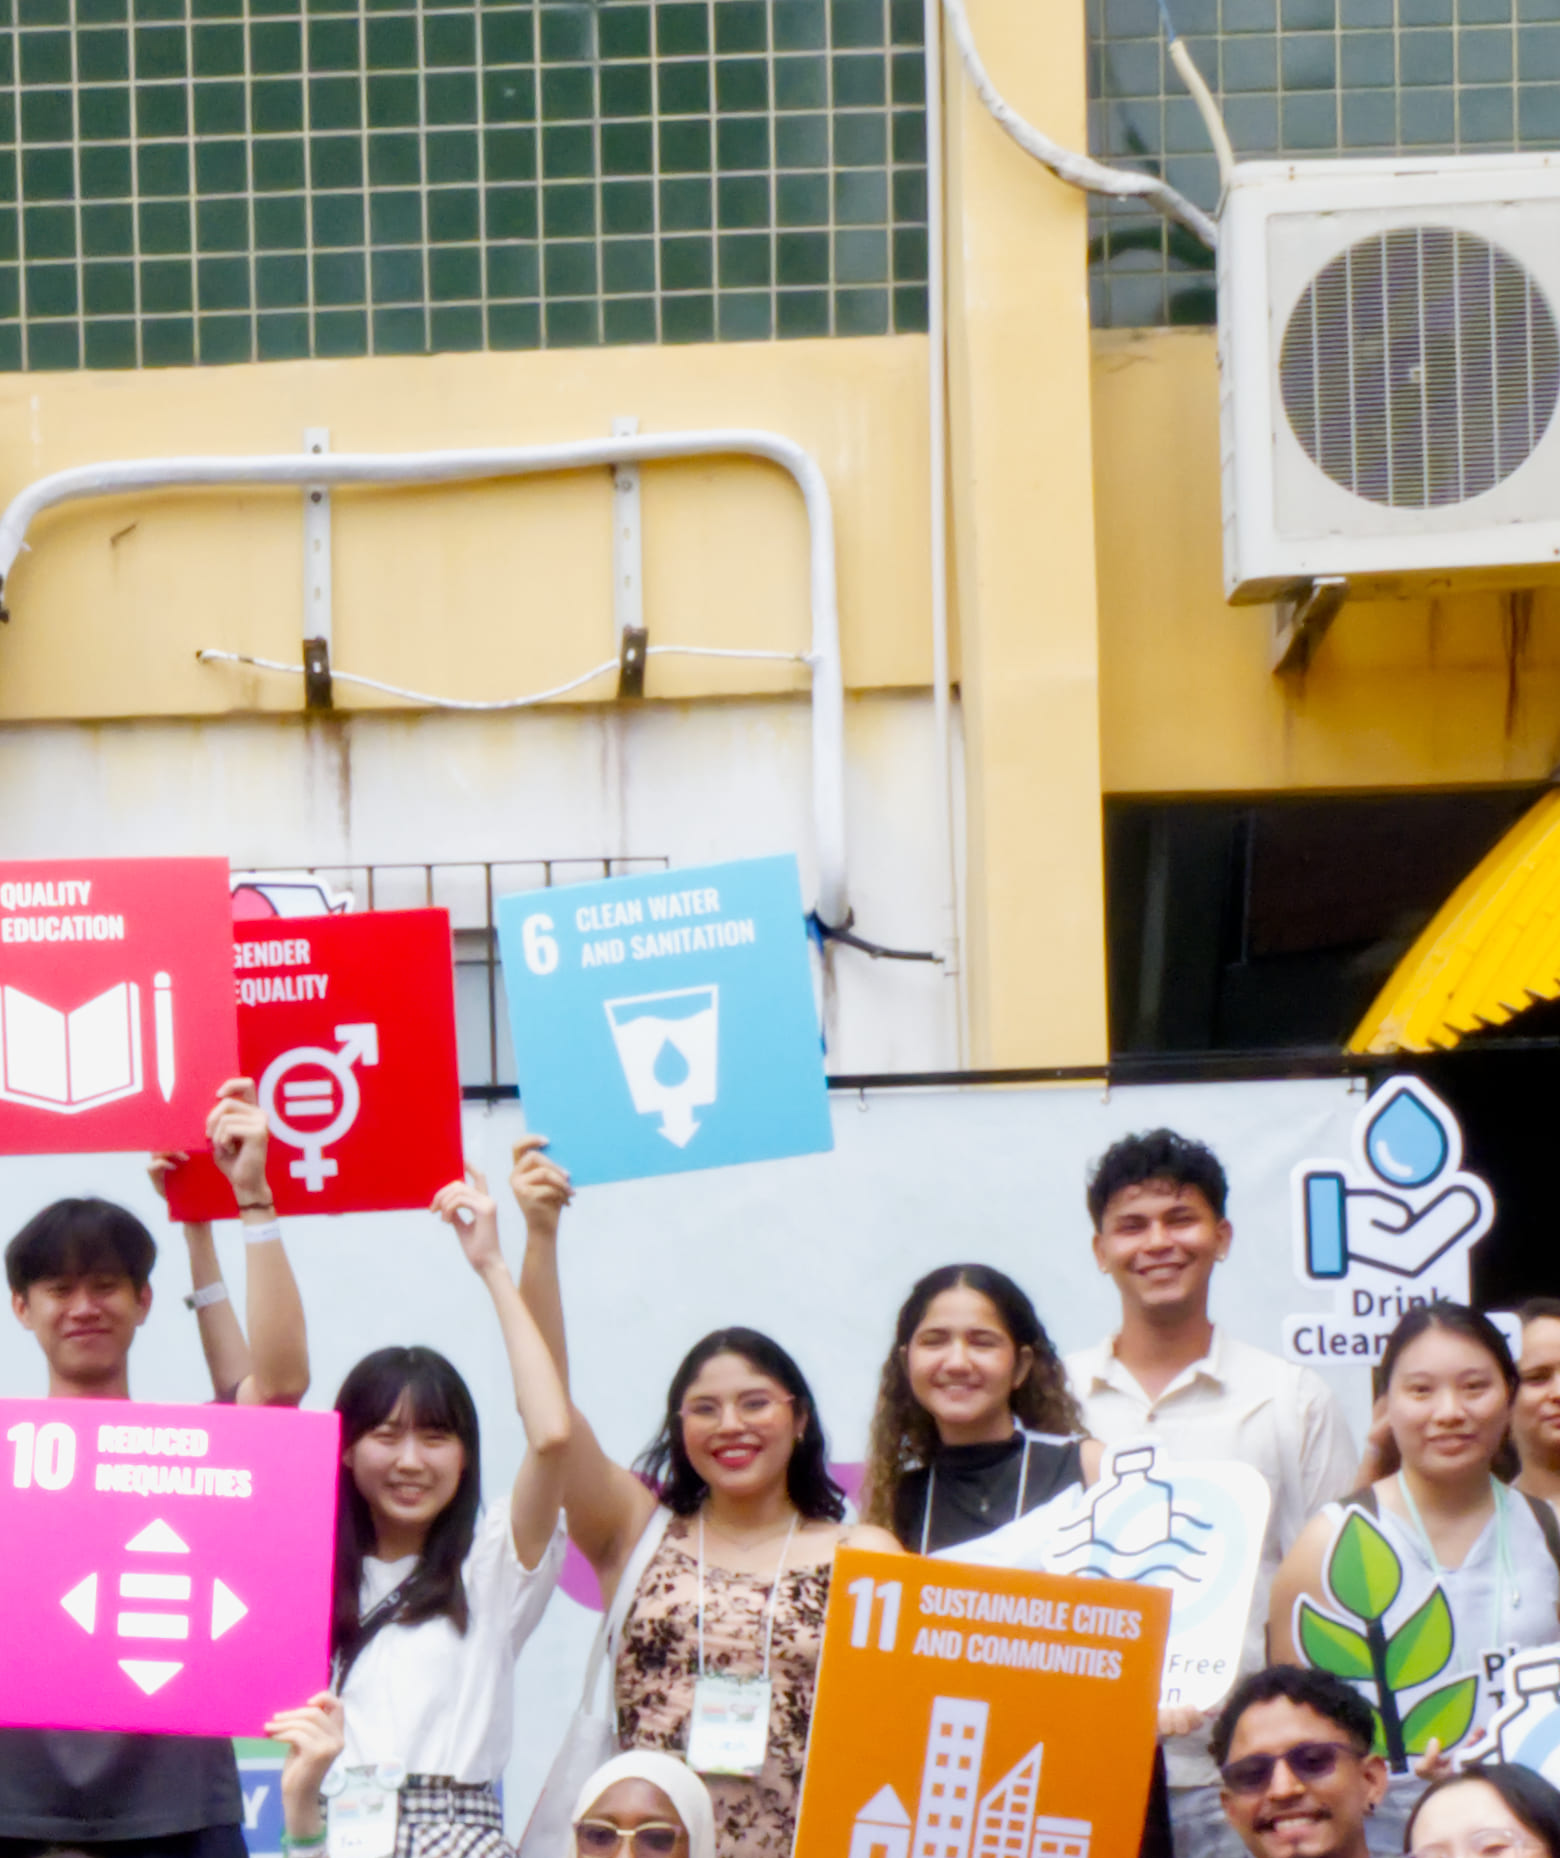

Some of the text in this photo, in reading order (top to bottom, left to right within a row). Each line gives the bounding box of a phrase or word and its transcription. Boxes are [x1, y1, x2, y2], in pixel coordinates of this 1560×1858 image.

[0, 881, 92, 909] QUALITY
[575, 888, 720, 932] CLEAN WATER
[1, 915, 124, 943] EDUCATION
[522, 913, 559, 975] 6
[581, 919, 755, 968] AND SANITATION
[7, 1422, 77, 1490] 10
[98, 1425, 209, 1457] REDUCED
[95, 1463, 252, 1498] INEQUALITIES
[848, 1577, 902, 1652] 11
[919, 1585, 1143, 1640] SUSTAINABLE CITIES
[913, 1627, 1123, 1680] AND COMMUNITIES
[1168, 1654, 1226, 1675] Free
